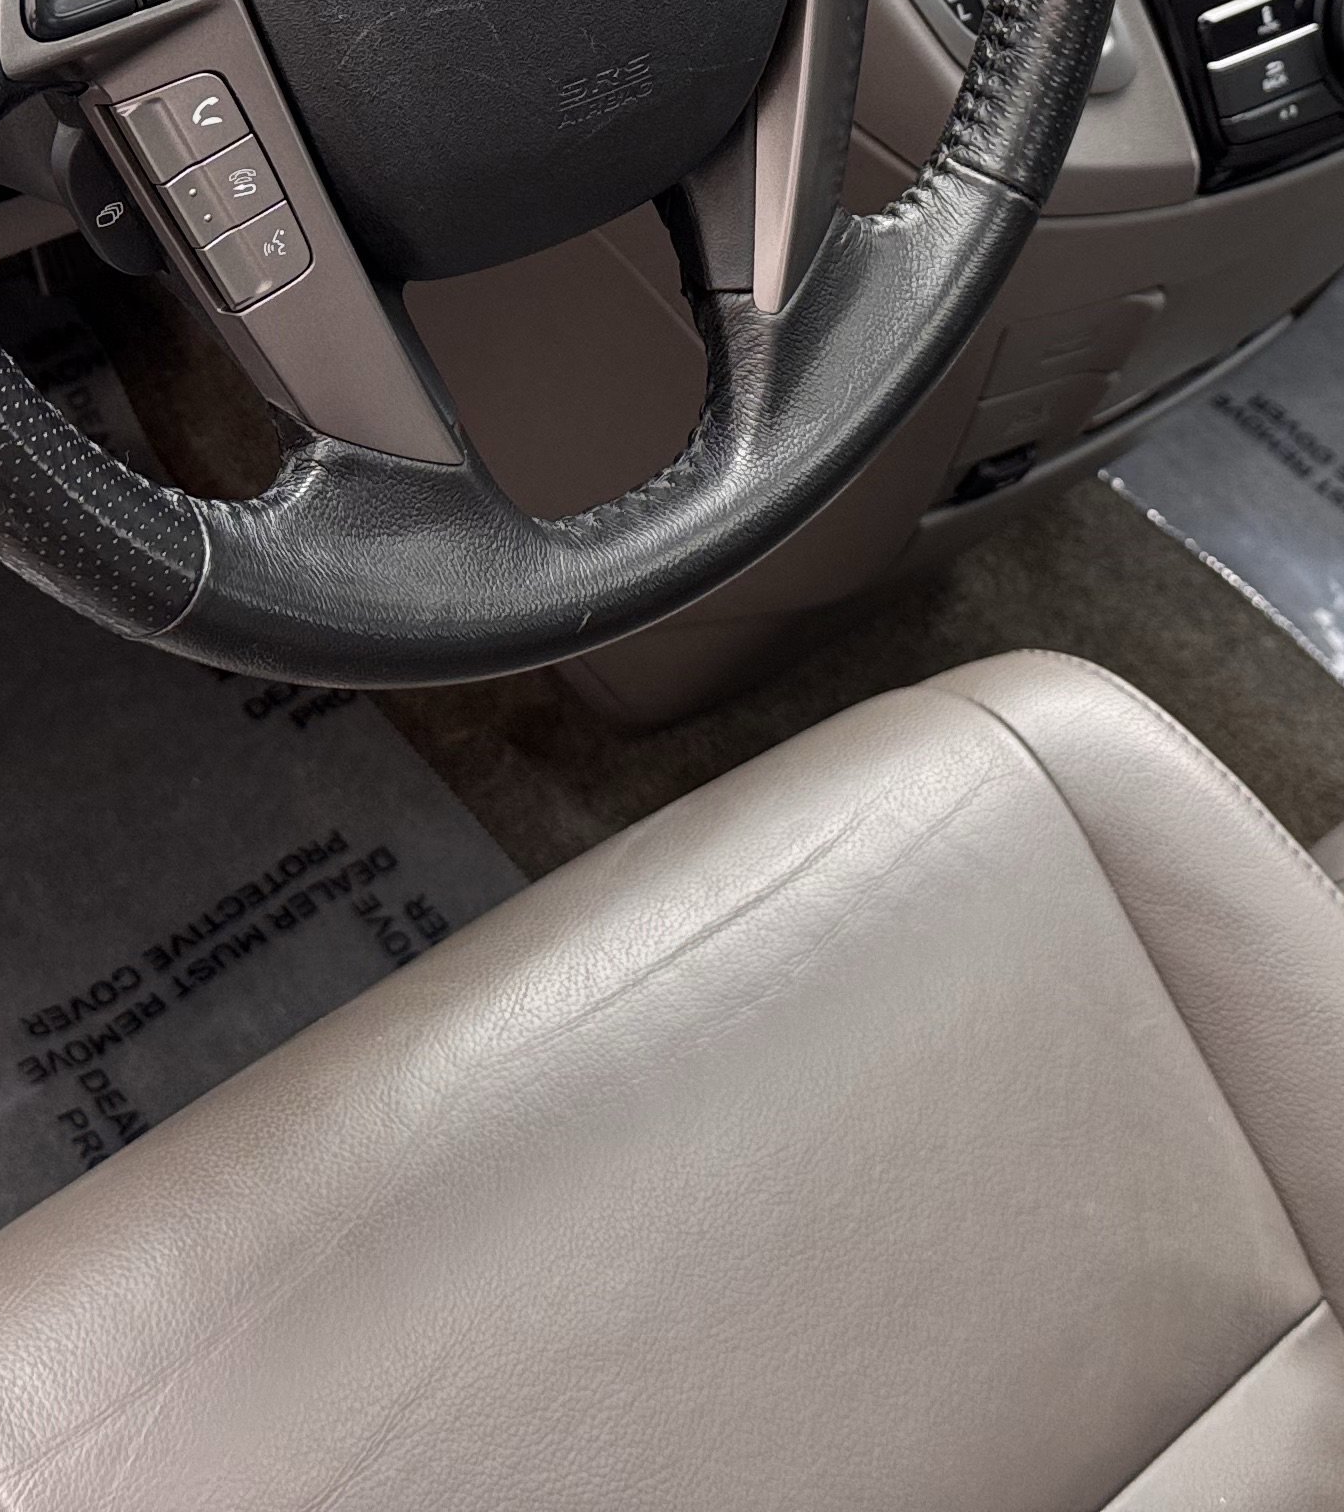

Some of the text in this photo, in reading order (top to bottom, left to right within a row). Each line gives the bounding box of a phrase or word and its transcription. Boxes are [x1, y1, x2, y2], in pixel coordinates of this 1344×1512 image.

[956, 3, 972, 23] L
[265, 845, 398, 931] DEALER
[18, 992, 166, 1085] REMOVE
[21, 964, 142, 1037] COVER
